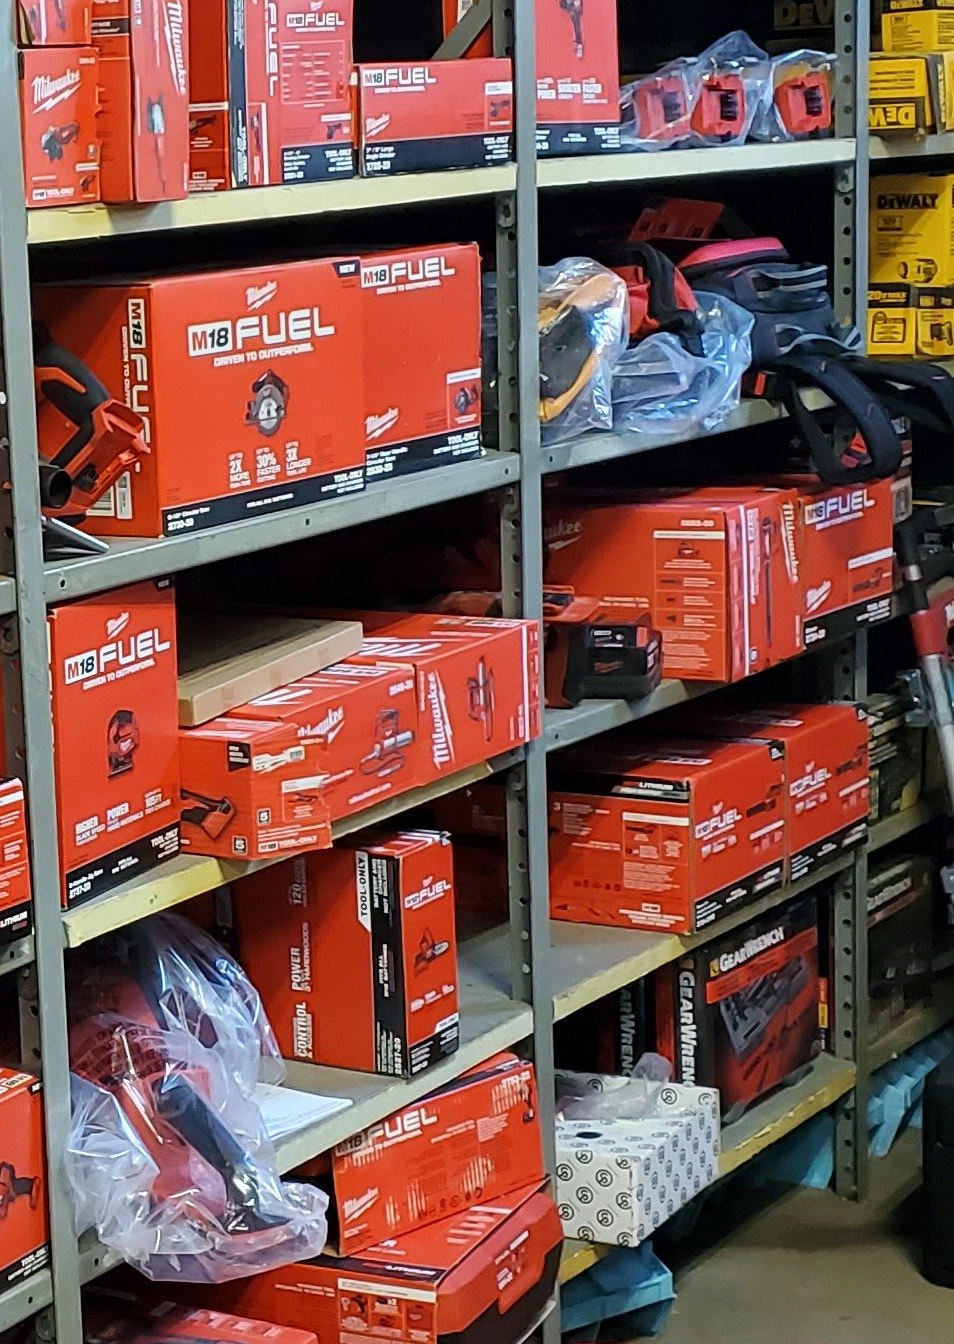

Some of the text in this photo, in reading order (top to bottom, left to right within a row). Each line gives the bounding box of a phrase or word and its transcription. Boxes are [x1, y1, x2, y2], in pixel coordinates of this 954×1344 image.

[305, 12, 346, 27] FUEL
[268, 3, 279, 97] FUEL
[30, 67, 81, 106] Milwaukee
[385, 67, 437, 86] FUEL
[877, 192, 939, 210] DEWALT
[364, 256, 456, 285] M18 FUEL
[130, 301, 144, 347] M18
[192, 307, 336, 352] M18 FUEL
[213, 351, 259, 368] DRIVEN TO
[229, 459, 244, 475] 2X
[256, 453, 277, 469] 30%
[824, 489, 876, 521] FUEL
[781, 501, 799, 584] Milwaukee
[68, 628, 171, 682] M18 FUEL
[427, 671, 451, 771] Milwaukee
[801, 767, 832, 790] FUEL
[710, 807, 743, 832] FUEL
[360, 856, 369, 918] TOOL-ONLY
[420, 880, 451, 904] FUEL
[719, 924, 785, 975] GEARWRENCH
[291, 947, 301, 992] POWER
[368, 1107, 437, 1146] FUEL
